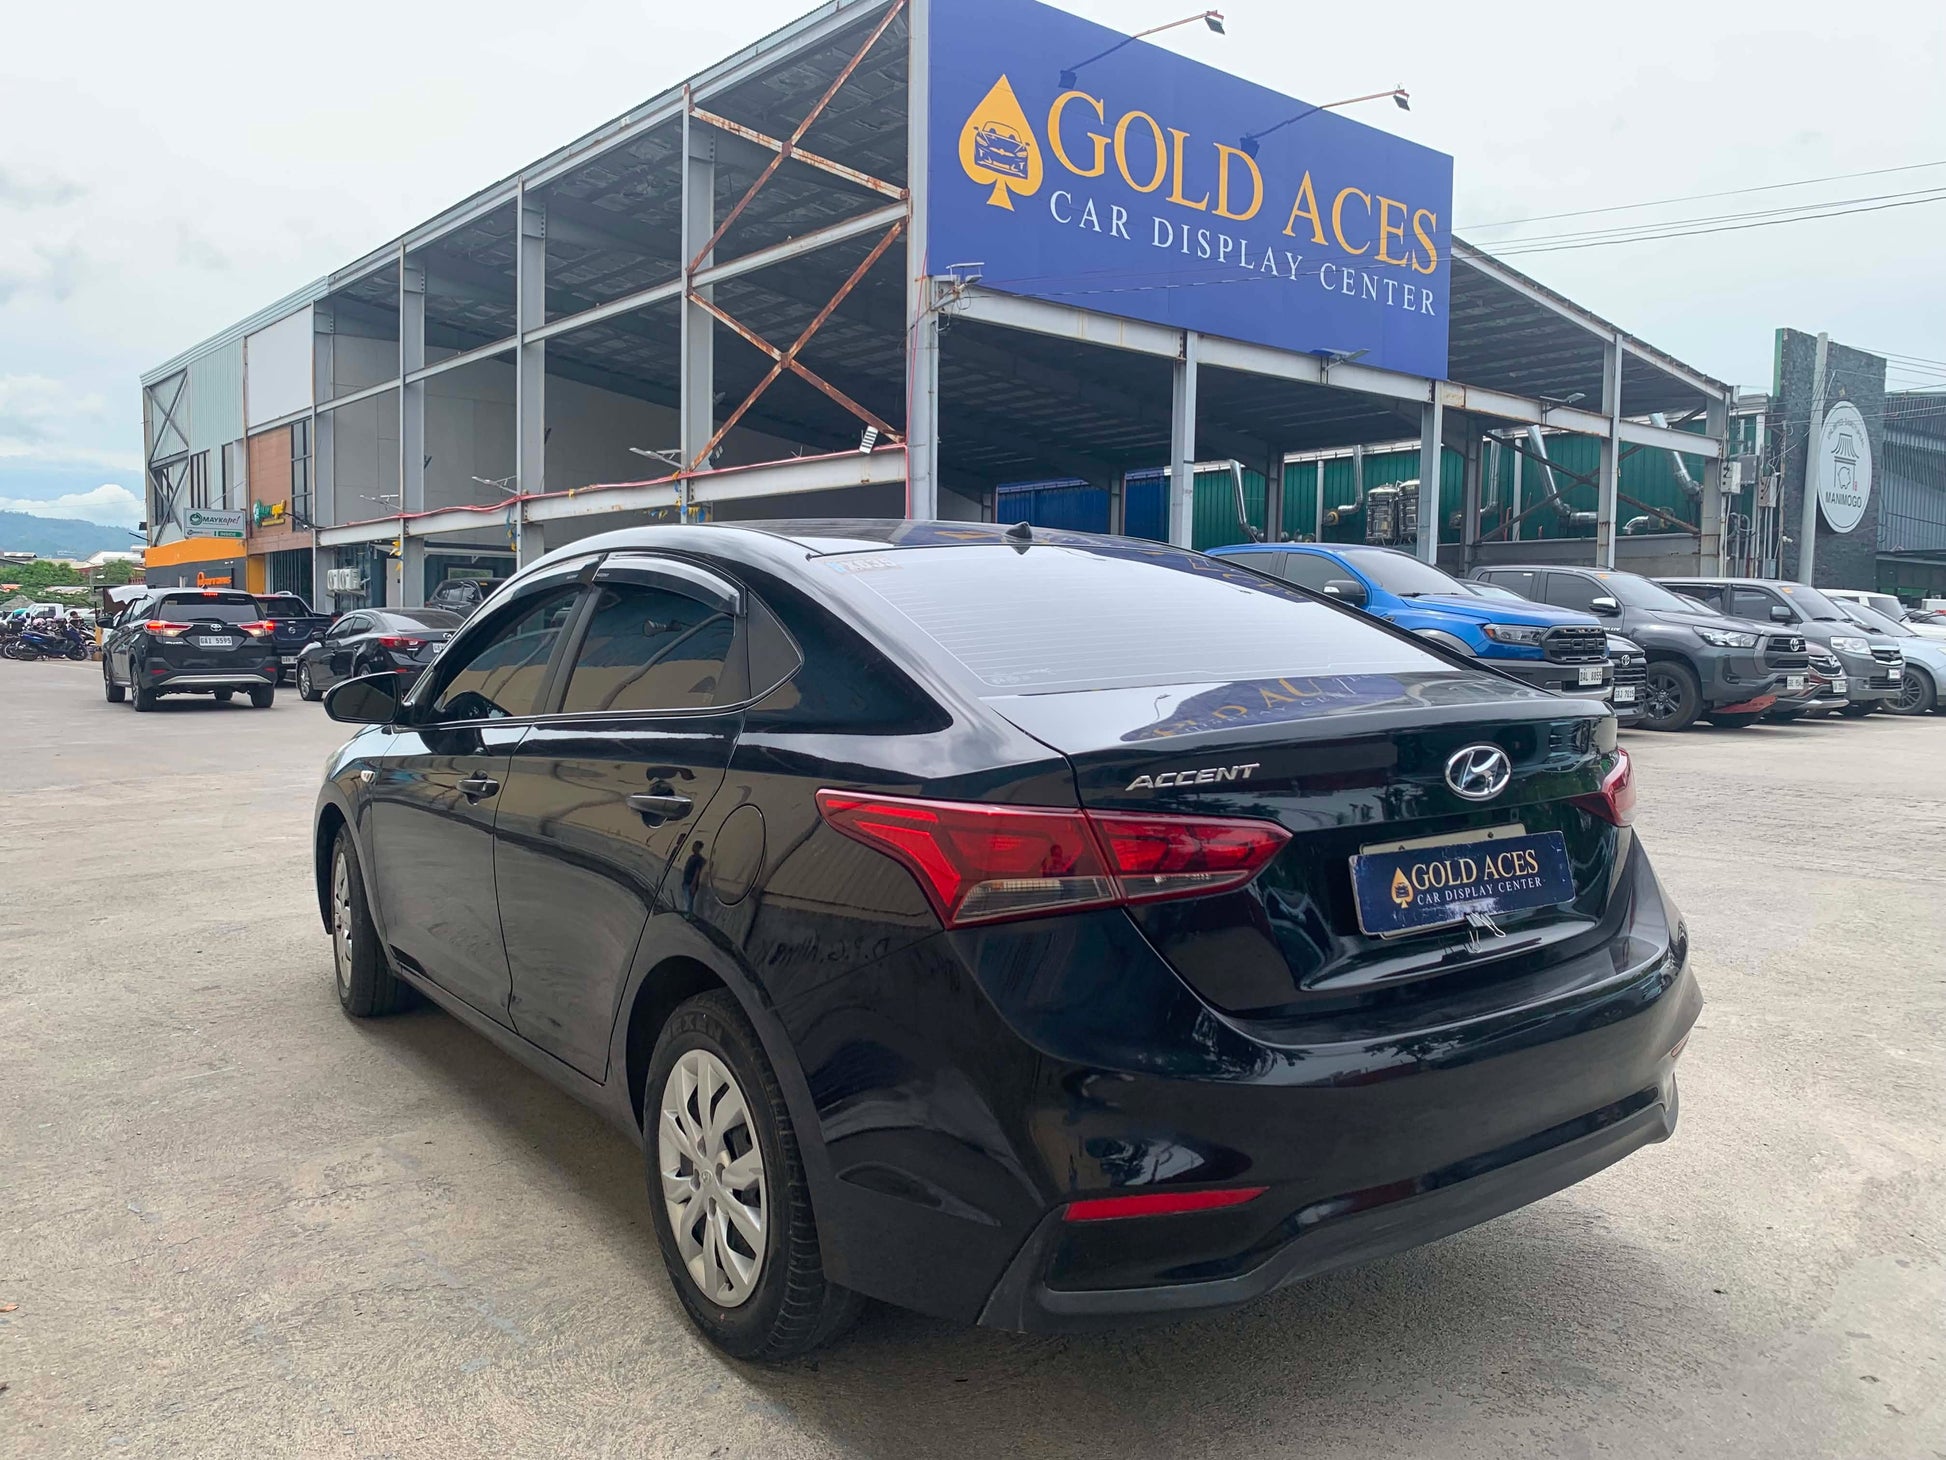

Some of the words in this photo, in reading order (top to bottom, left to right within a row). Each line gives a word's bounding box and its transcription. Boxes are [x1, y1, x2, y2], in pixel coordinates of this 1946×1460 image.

[1047, 90, 1264, 221] GOLD
[1283, 170, 1438, 275] ACES
[1050, 191, 1131, 240] CAR
[1152, 216, 1303, 281] DISPLAY
[1320, 263, 1436, 316] CENTER
[1825, 491, 1861, 508] MANIMOGO
[1125, 763, 1260, 791] ACCENT
[1411, 857, 1477, 890] GOLD
[1484, 849, 1539, 880] ACES
[1417, 891, 1441, 905] CAR
[1445, 883, 1493, 901] DISPLAY
[1498, 876, 1542, 893] CENTER
